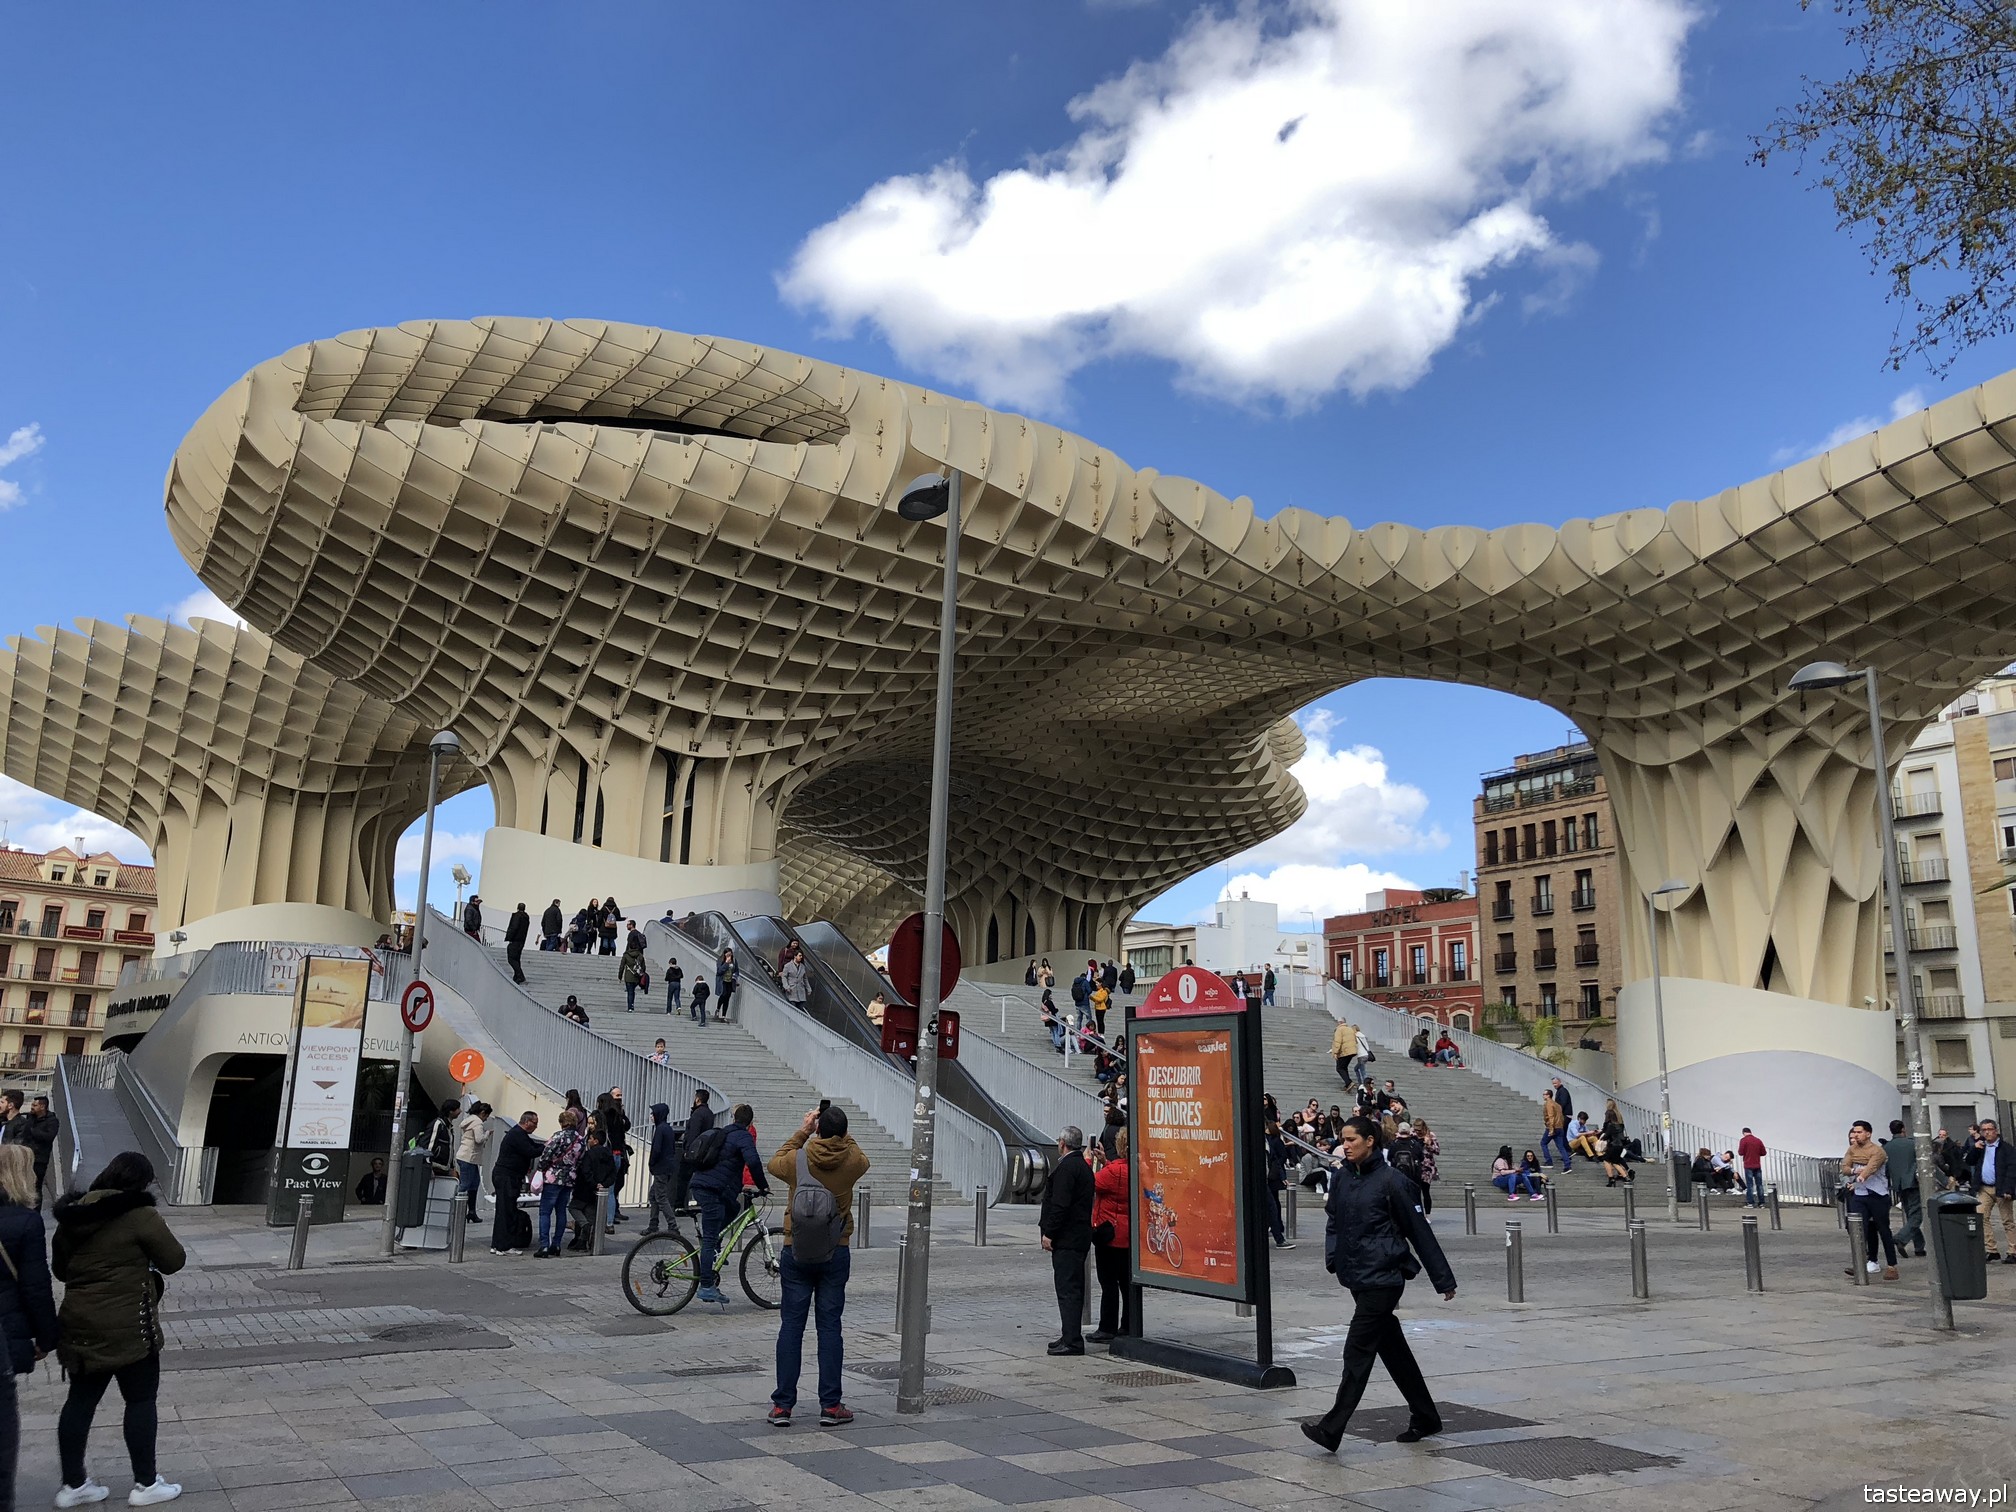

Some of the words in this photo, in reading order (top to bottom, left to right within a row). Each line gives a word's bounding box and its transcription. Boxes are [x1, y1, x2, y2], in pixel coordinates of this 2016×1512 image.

[1372, 908, 1420, 928] HOTEL
[271, 964, 297, 980] PIL
[237, 1032, 290, 1046] ANTIQV
[362, 1037, 400, 1052] SEVILLA
[301, 1045, 358, 1053] VIEWPOINT
[1197, 1040, 1228, 1054] easyJet
[306, 1053, 349, 1061] ACCESS
[1148, 1066, 1202, 1086] DESCUBRIR
[1147, 1087, 1160, 1098] QUE
[1185, 1087, 1194, 1098] EN
[1148, 1100, 1202, 1126] LONDRES
[1173, 1128, 1180, 1139] ES
[1180, 1128, 1190, 1140] UNA
[1190, 1129, 1223, 1141] MARAVILLA
[284, 1178, 310, 1189] Past
[313, 1178, 342, 1189] View
